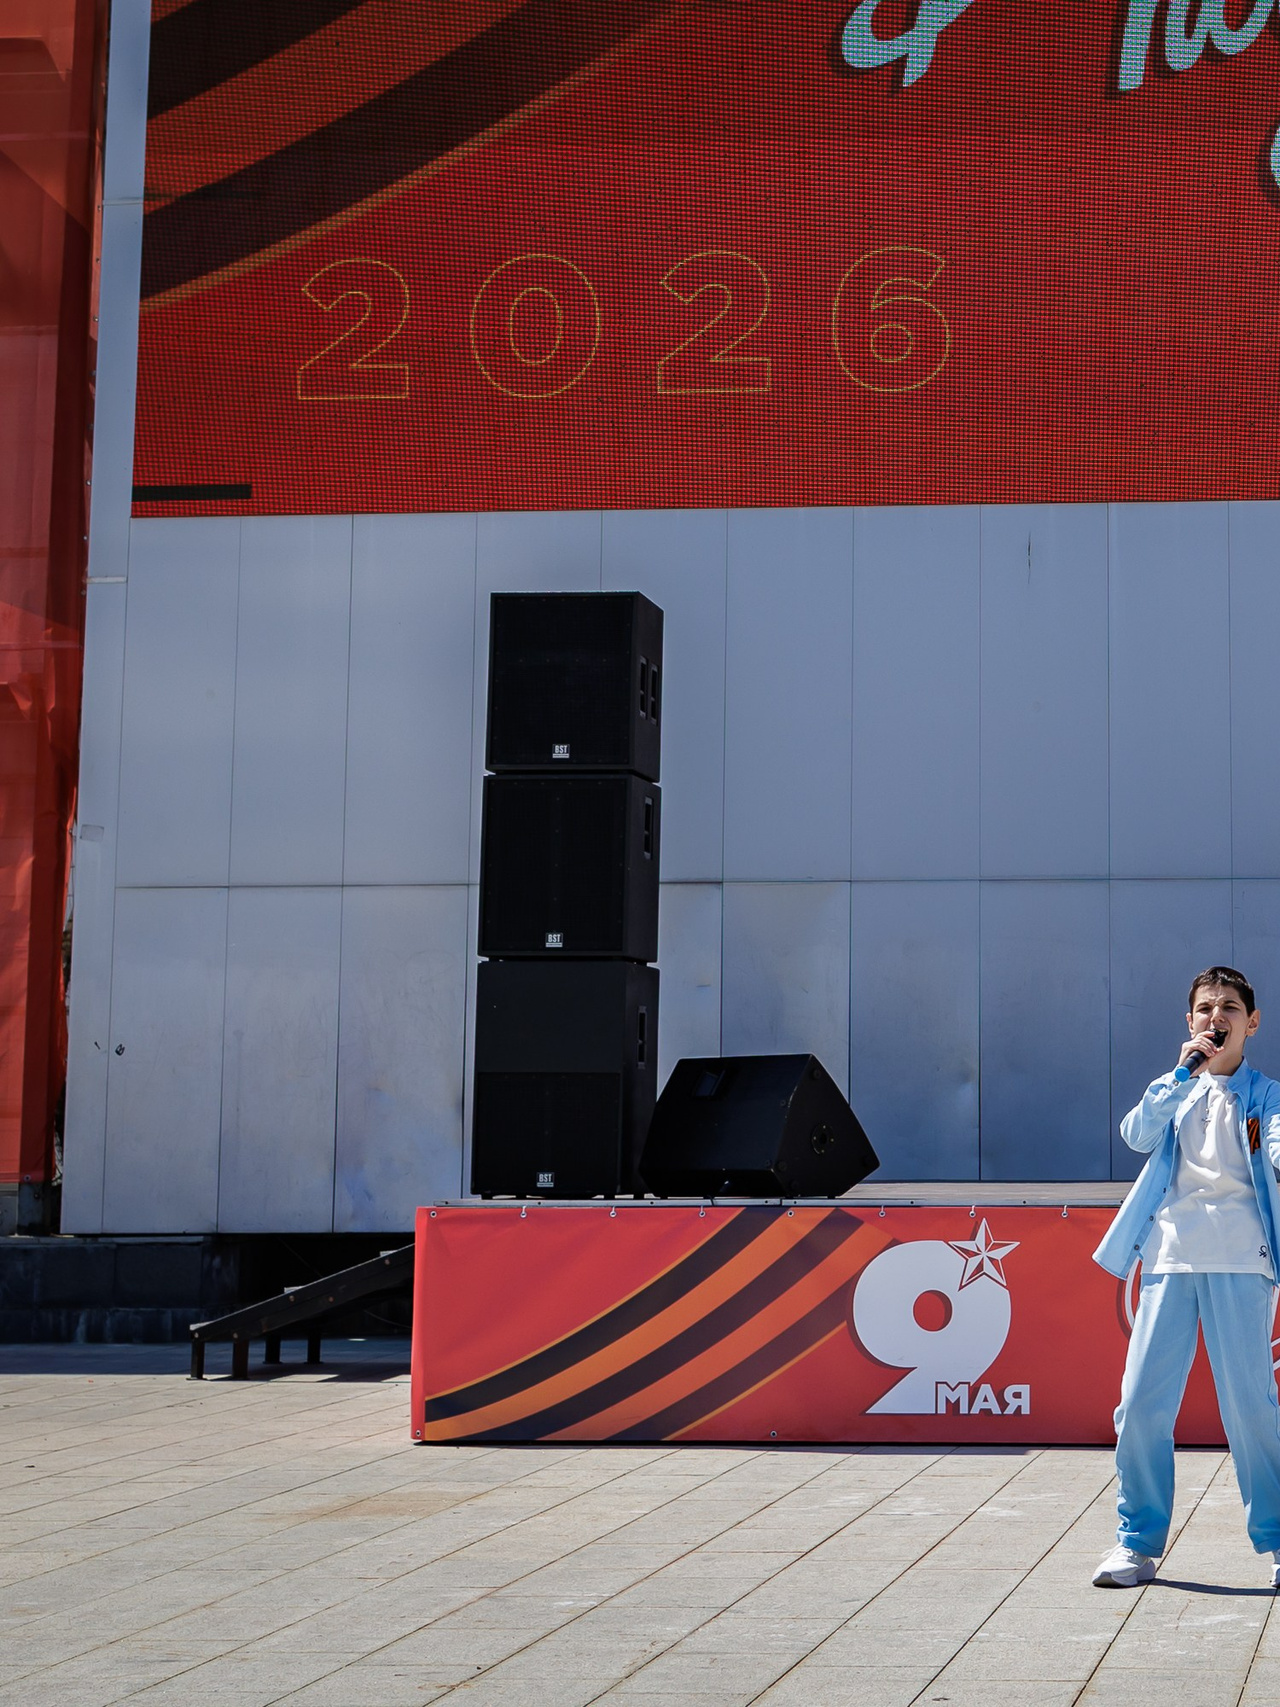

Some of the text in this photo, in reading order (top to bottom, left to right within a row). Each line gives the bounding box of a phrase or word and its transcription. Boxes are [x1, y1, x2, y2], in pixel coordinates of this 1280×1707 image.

[298, 246, 950, 400] 2026
[554, 745, 568, 754] BST
[548, 934, 561, 943] BST
[538, 1173, 552, 1183] BST
[853, 1240, 1011, 1414] 9
[937, 1384, 1031, 1414] МАЯ
